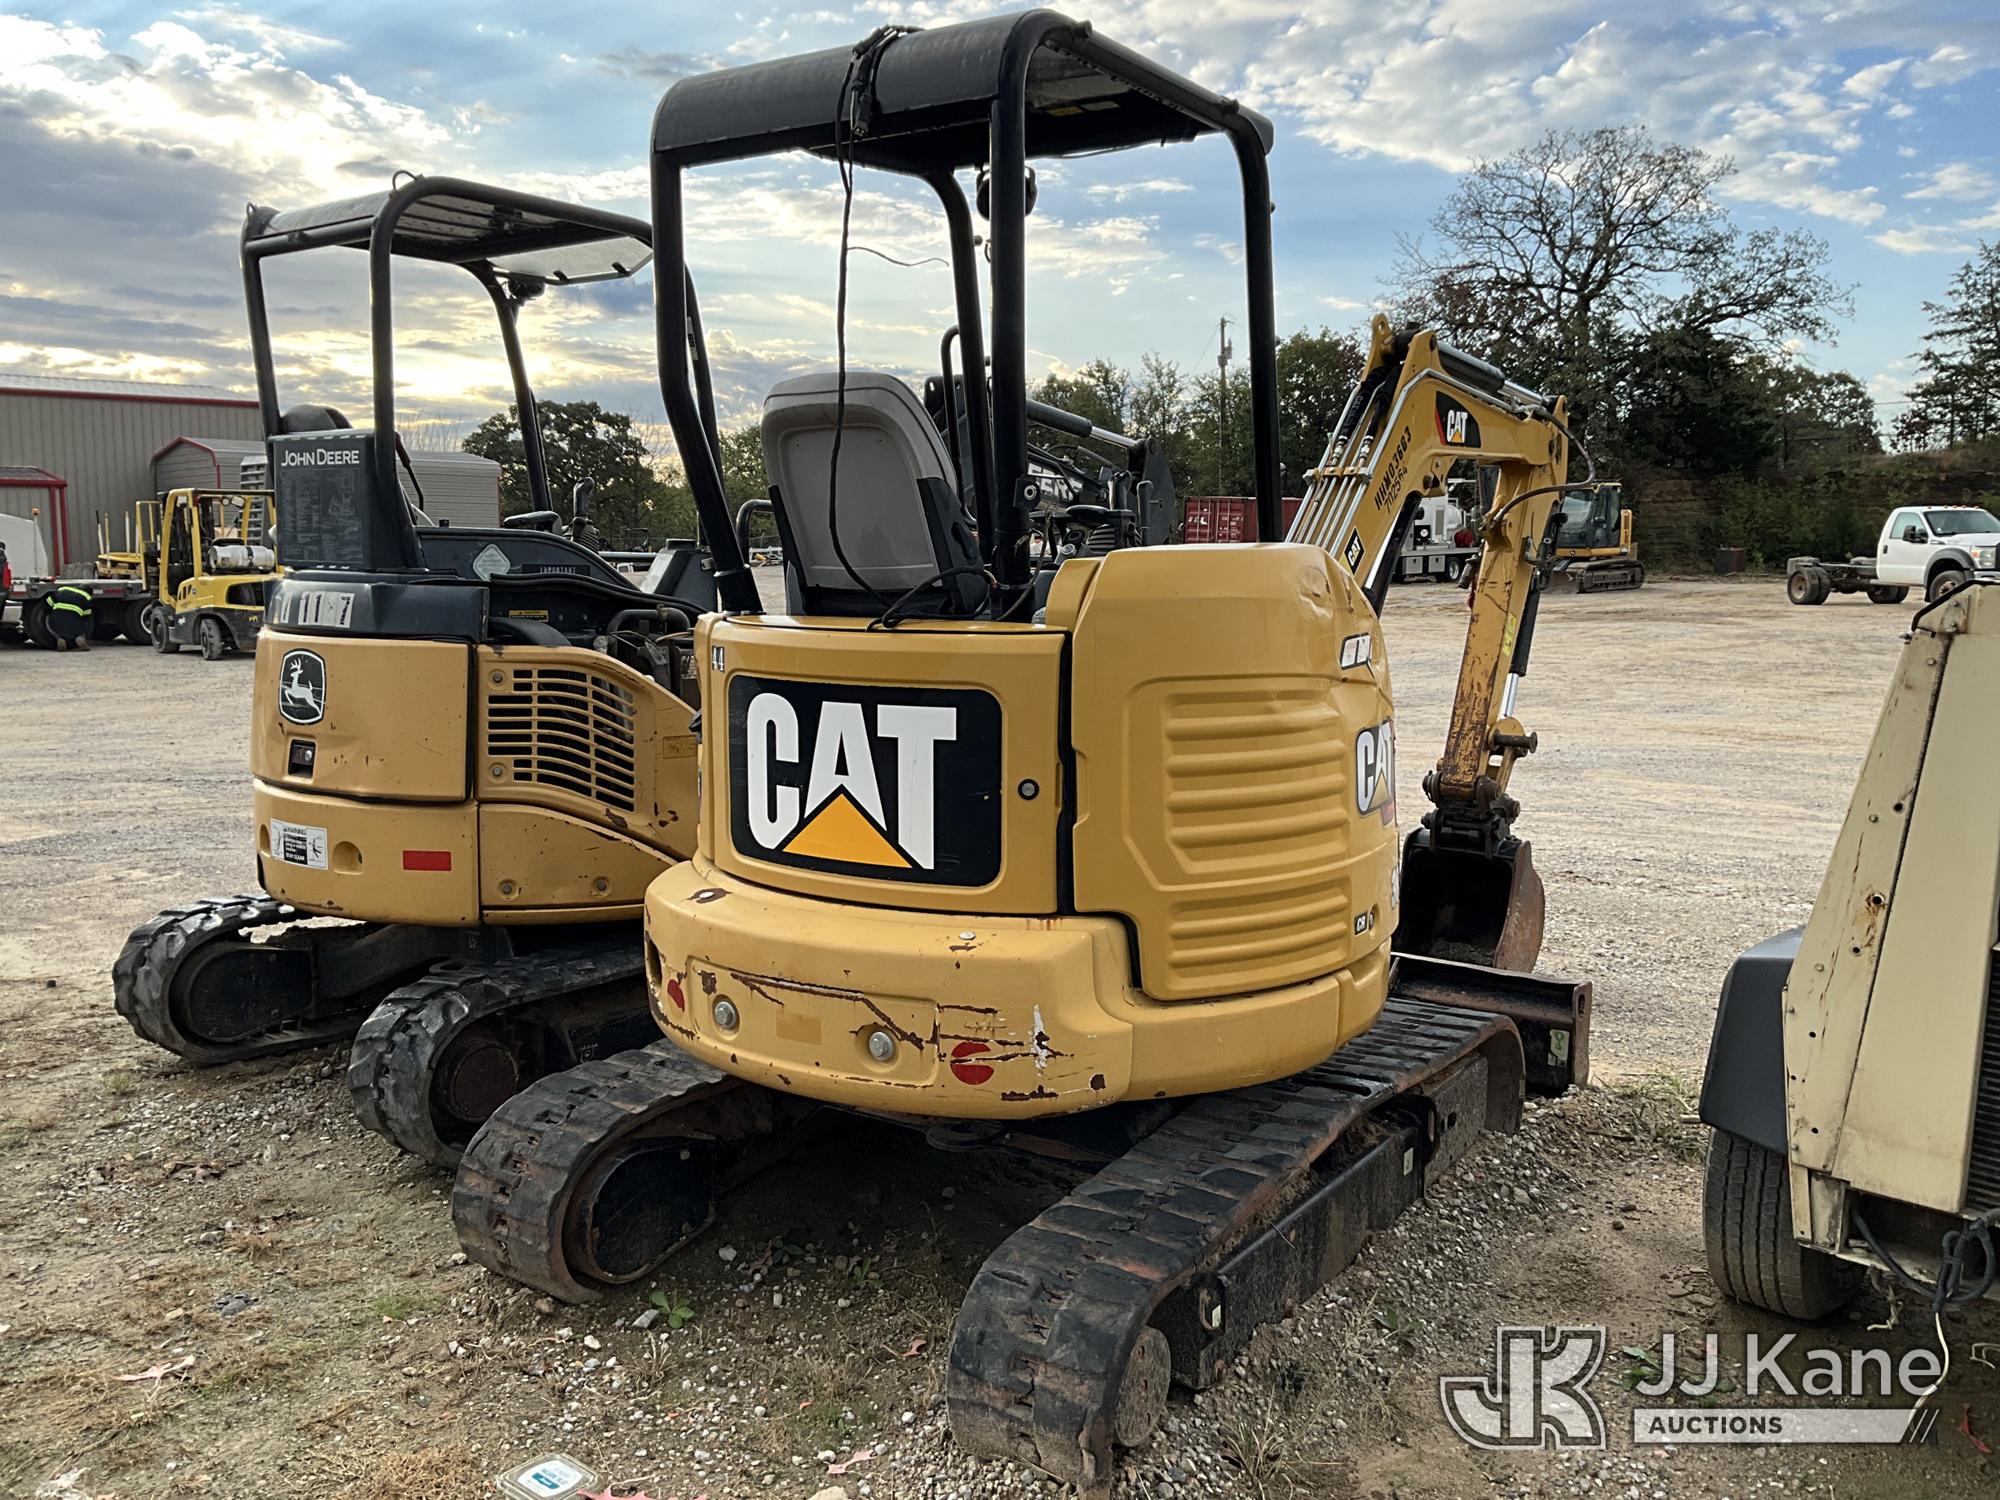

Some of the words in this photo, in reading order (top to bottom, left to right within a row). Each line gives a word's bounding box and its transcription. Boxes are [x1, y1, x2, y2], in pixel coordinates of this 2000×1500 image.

[1446, 409, 1468, 444] CAT
[281, 449, 315, 467] JOHN
[316, 448, 360, 465] DEERE
[1347, 535, 1362, 567] CAT
[747, 692, 957, 869] CAT
[1357, 721, 1392, 812] CAT
